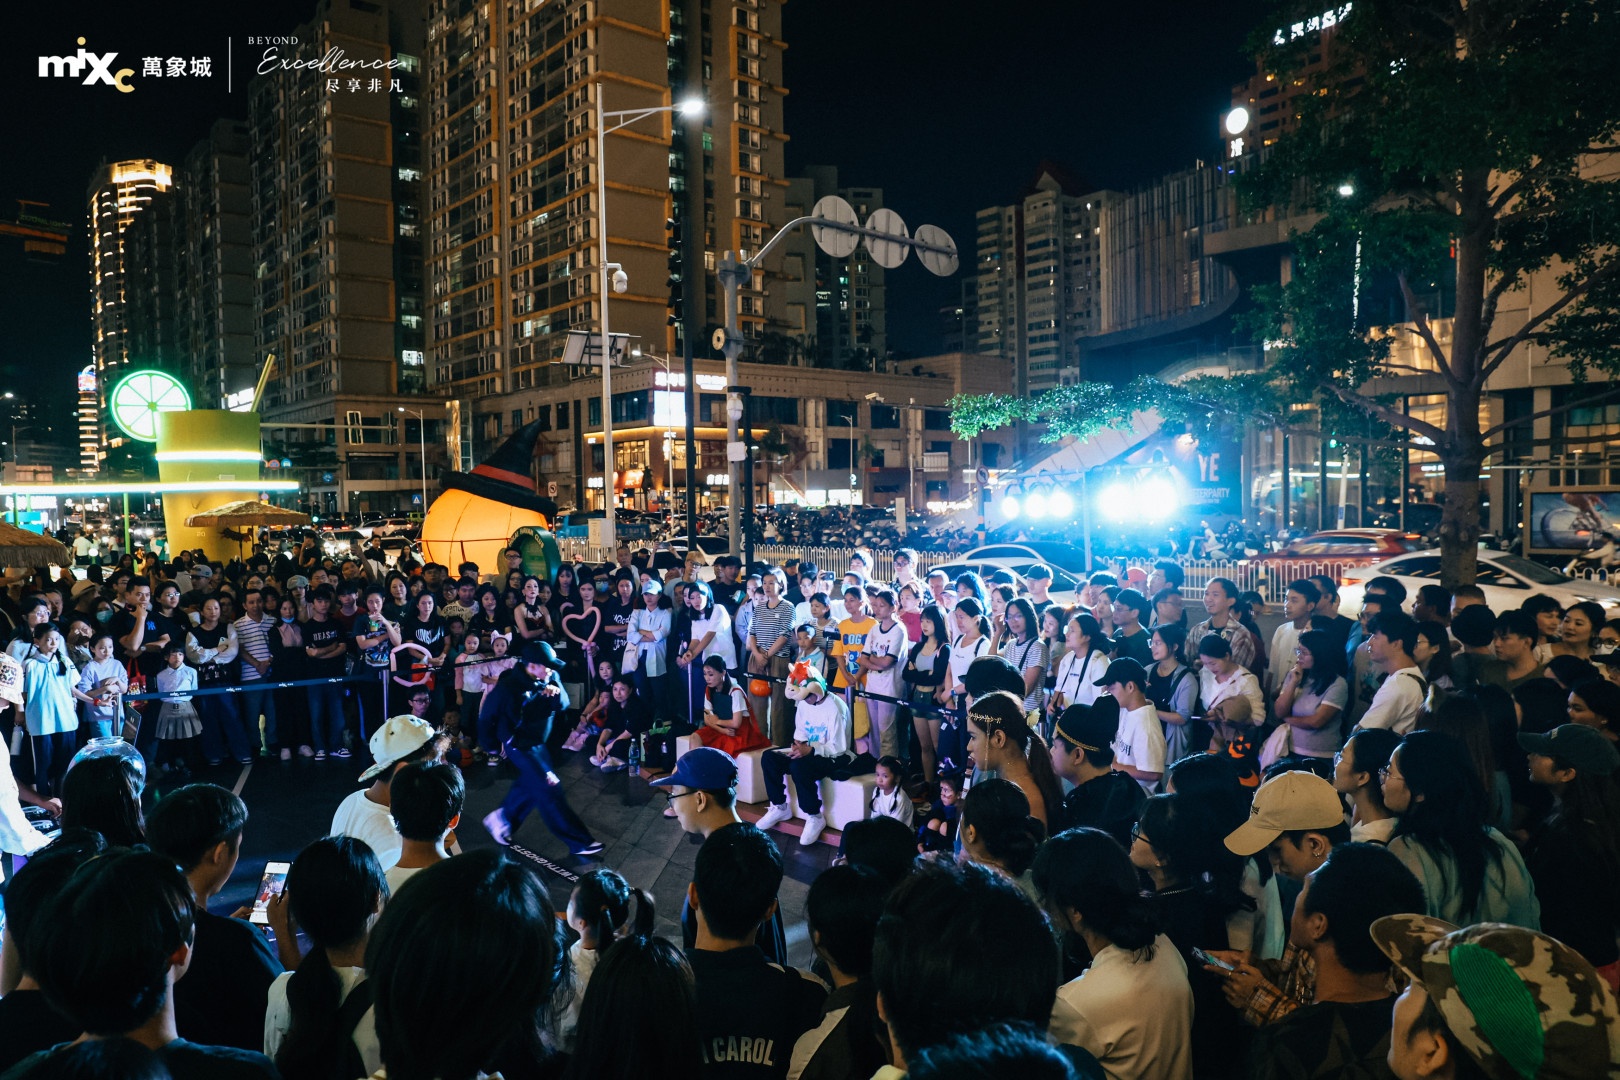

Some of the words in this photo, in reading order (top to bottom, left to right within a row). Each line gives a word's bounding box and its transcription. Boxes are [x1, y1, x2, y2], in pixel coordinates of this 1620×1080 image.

[1198, 452, 1219, 482] YE
[509, 844, 549, 865] GHOSTS
[543, 862, 573, 878] WITH
